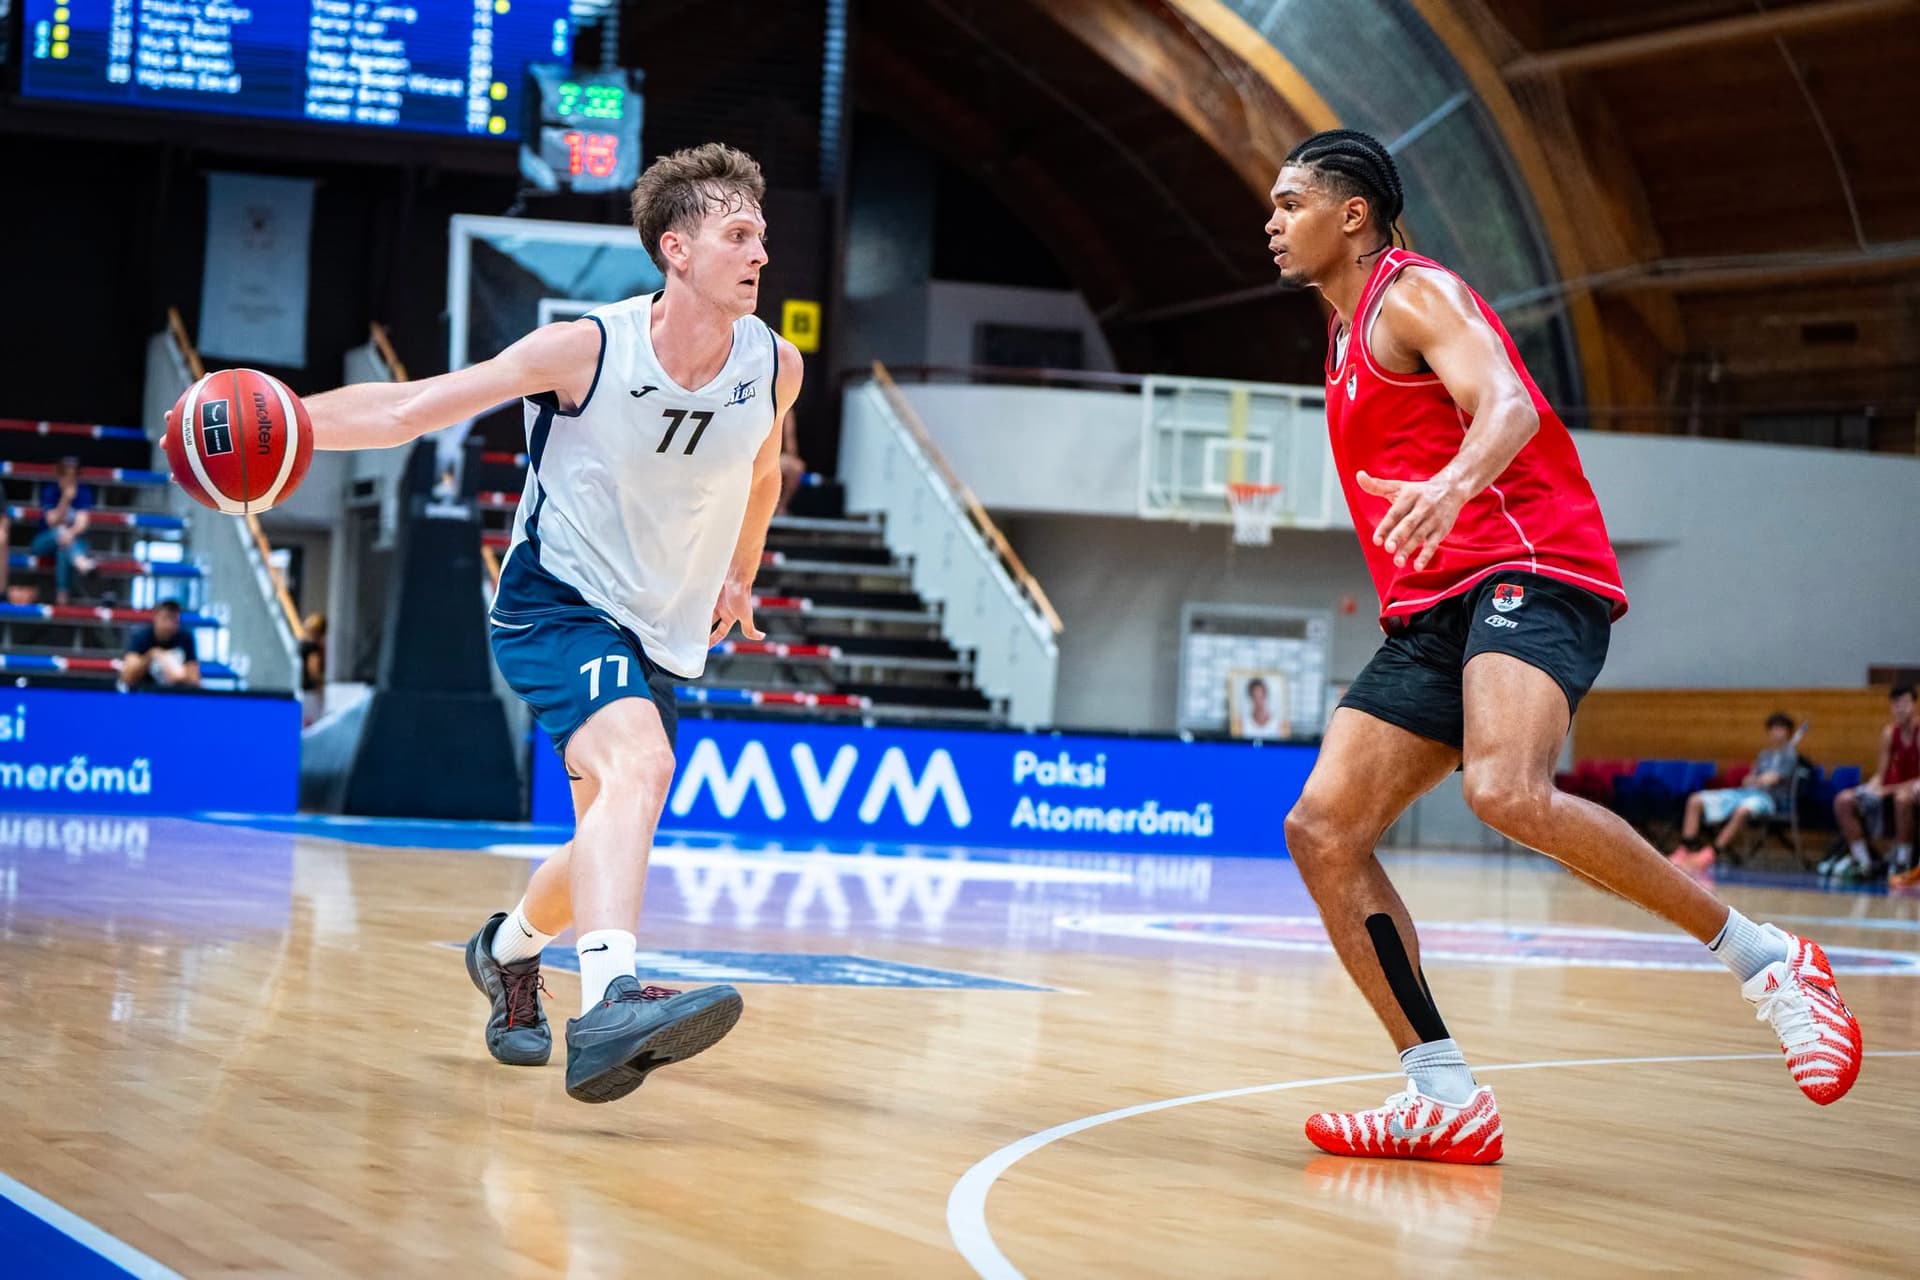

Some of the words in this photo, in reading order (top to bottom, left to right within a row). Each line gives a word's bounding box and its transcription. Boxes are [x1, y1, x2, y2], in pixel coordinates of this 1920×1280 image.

[252, 391, 273, 455] molten
[655, 408, 715, 455] 77
[579, 655, 629, 701] 77
[671, 738, 972, 827] MVM
[1013, 750, 1107, 788] Paksi
[1011, 797, 1214, 837] Atomerőmű
